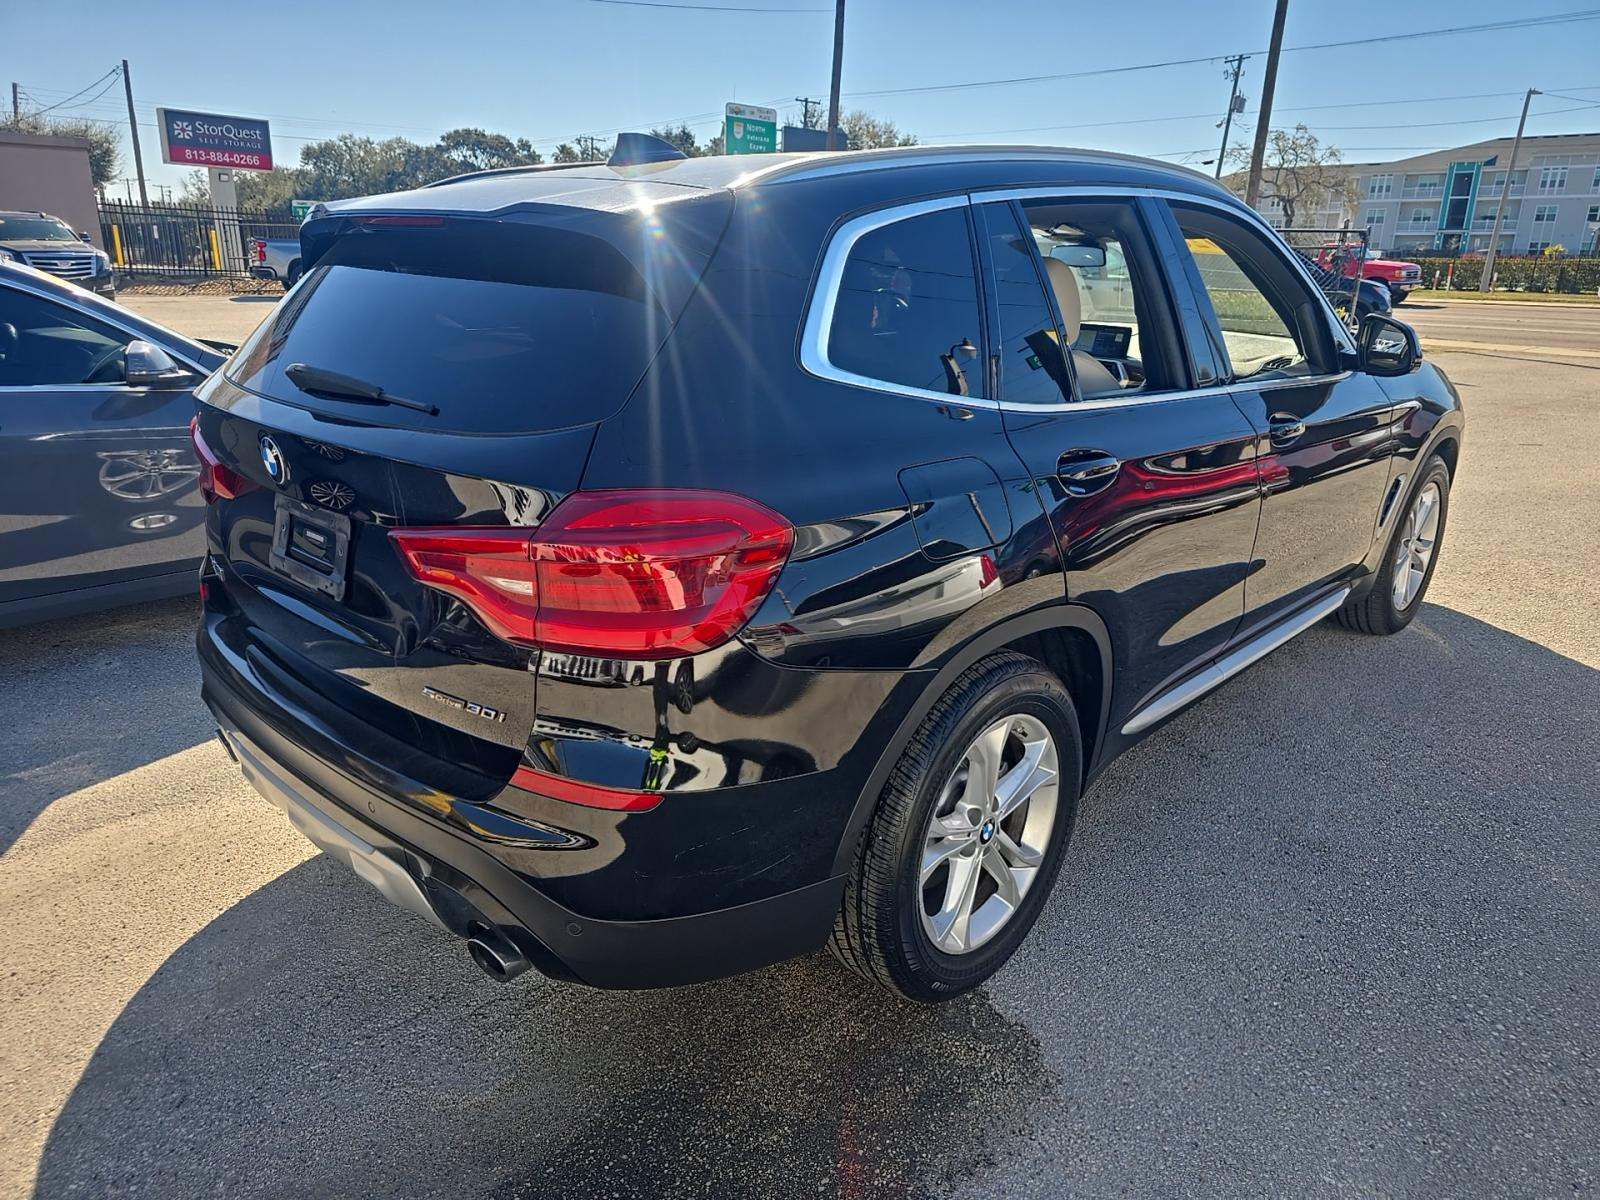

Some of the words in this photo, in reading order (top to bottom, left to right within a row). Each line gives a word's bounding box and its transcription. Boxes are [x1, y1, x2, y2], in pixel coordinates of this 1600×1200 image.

[195, 121, 262, 140] StorQuest
[224, 140, 262, 149] STORAGE
[185, 149, 260, 165] 813-884-0266
